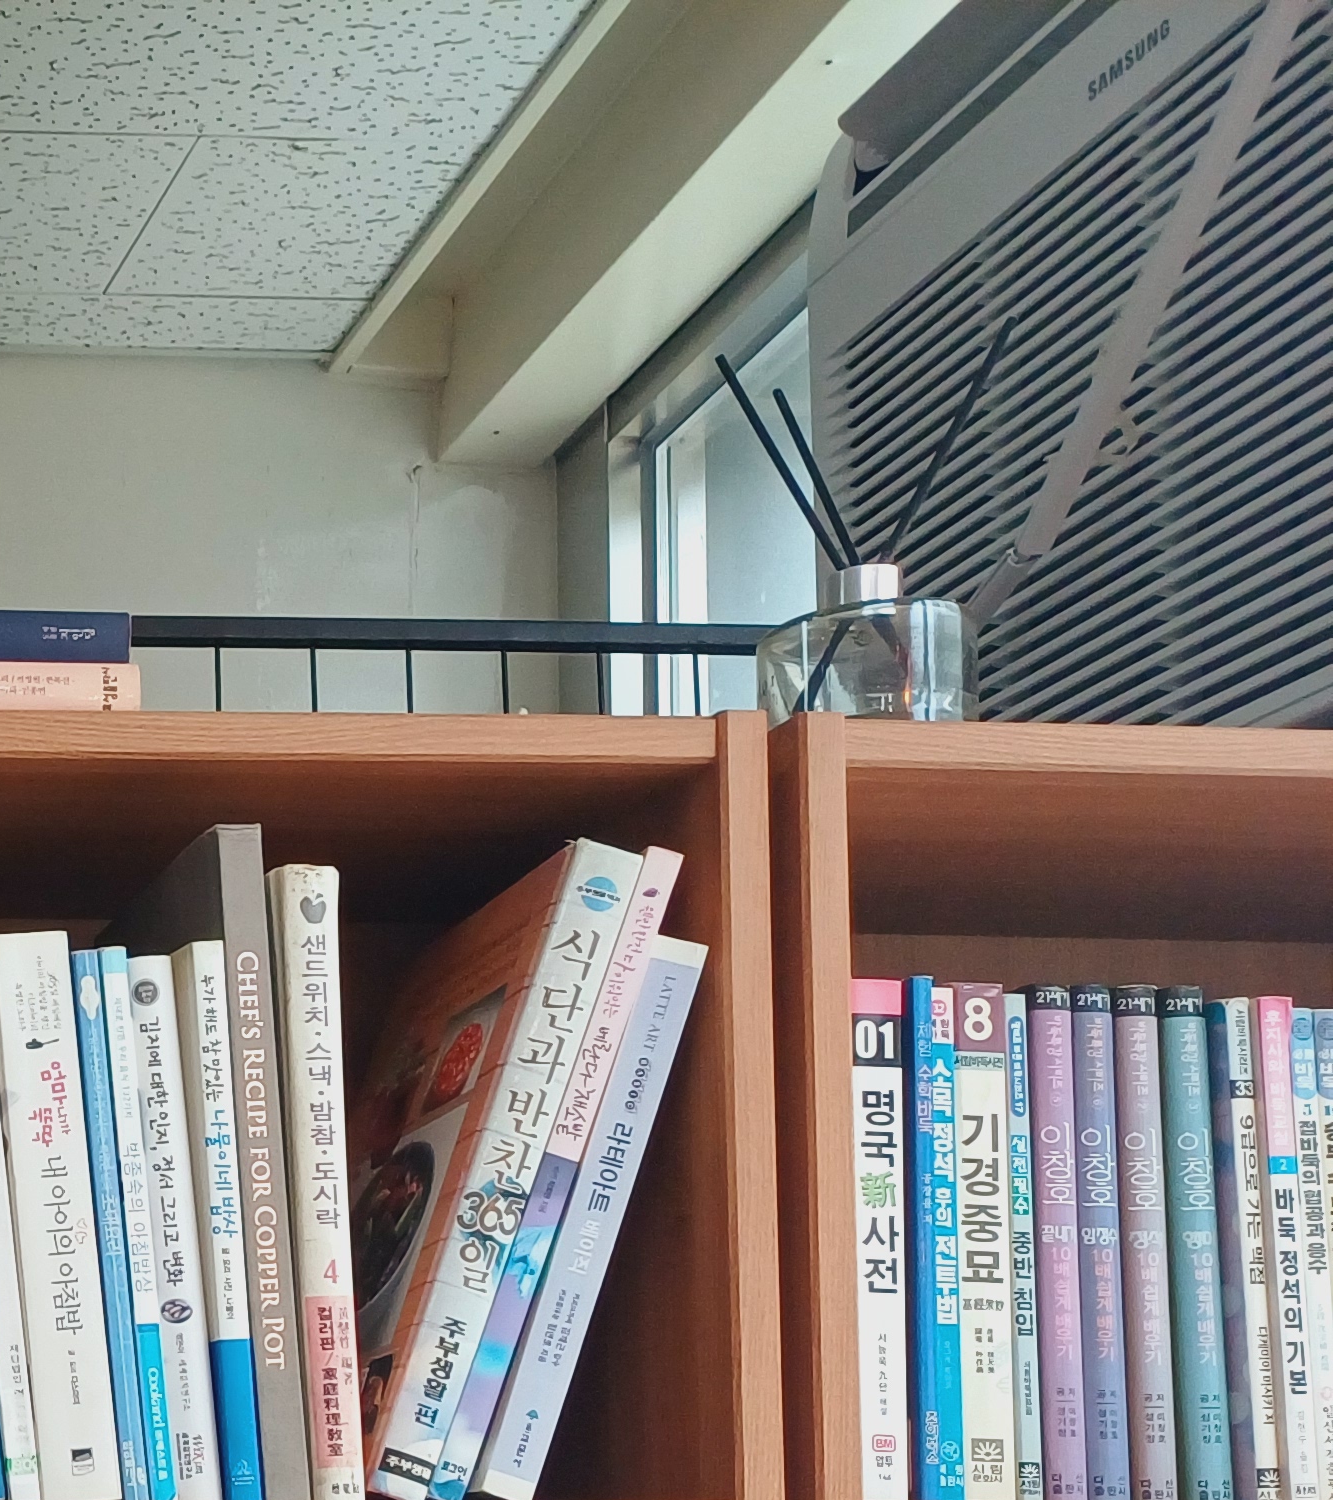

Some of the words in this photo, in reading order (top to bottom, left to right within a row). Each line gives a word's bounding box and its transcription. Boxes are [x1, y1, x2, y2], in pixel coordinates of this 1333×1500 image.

[1087, 18, 1172, 102] SAMSUNG
[139, 1017, 166, 1067] 김치에
[854, 1018, 896, 1057] 01
[963, 997, 994, 1042] 8
[147, 1073, 168, 1107] 대한
[155, 1155, 176, 1190] 정서
[248, 1147, 273, 1202] FOR
[1039, 1122, 1076, 1207] 이창호
[1079, 1123, 1117, 1209] 이창호
[1124, 1126, 1163, 1212] 이창호
[1176, 1126, 1214, 1213] 이창호
[160, 1195, 181, 1247] 그리고
[959, 1113, 1004, 1285] 기경중묘
[164, 1251, 186, 1287] 변화
[252, 1205, 280, 1312] COPPER
[323, 1259, 341, 1285] 4
[261, 1316, 286, 1371] POT
